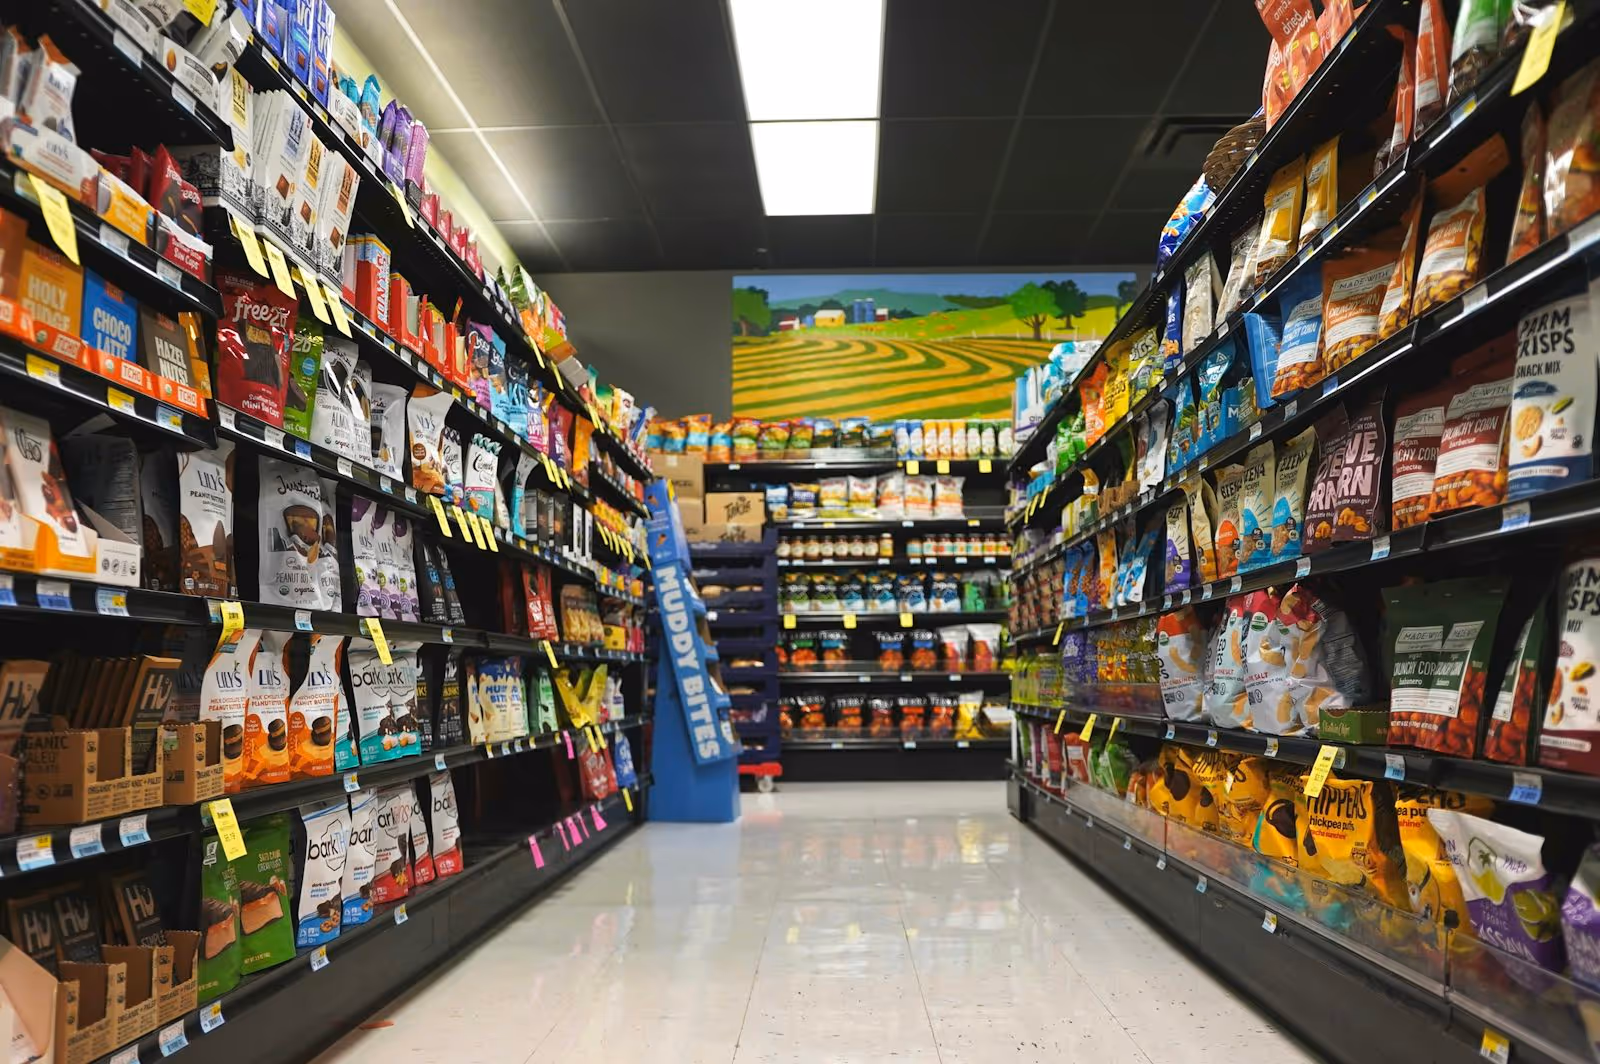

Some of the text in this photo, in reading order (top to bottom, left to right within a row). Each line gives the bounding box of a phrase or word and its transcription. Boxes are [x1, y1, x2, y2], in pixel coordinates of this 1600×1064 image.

[1281, 8, 1304, 35] dried
[27, 273, 67, 312] HOLY
[93, 306, 132, 346] CHOCO
[1519, 305, 1572, 339] PARM
[154, 335, 187, 369] HAZEL
[1519, 328, 1576, 360] RISPS
[122, 364, 141, 386] TCHO
[1516, 360, 1561, 379] SNACK MIX
[178, 387, 197, 408] TCHO
[1442, 415, 1499, 443] CRUNCHY CORN
[1448, 436, 1477, 449] barbecue
[196, 468, 226, 494] LILY'S
[190, 490, 210, 500] PEANUT
[275, 571, 299, 584] PEANUT
[294, 585, 315, 596] organic
[1566, 618, 1583, 633] MIX
[656, 564, 721, 760] MUDDY BITES
[215, 671, 243, 689] LILY'S
[1309, 814, 1342, 832] hickpea
[1504, 853, 1528, 873] PALEO
